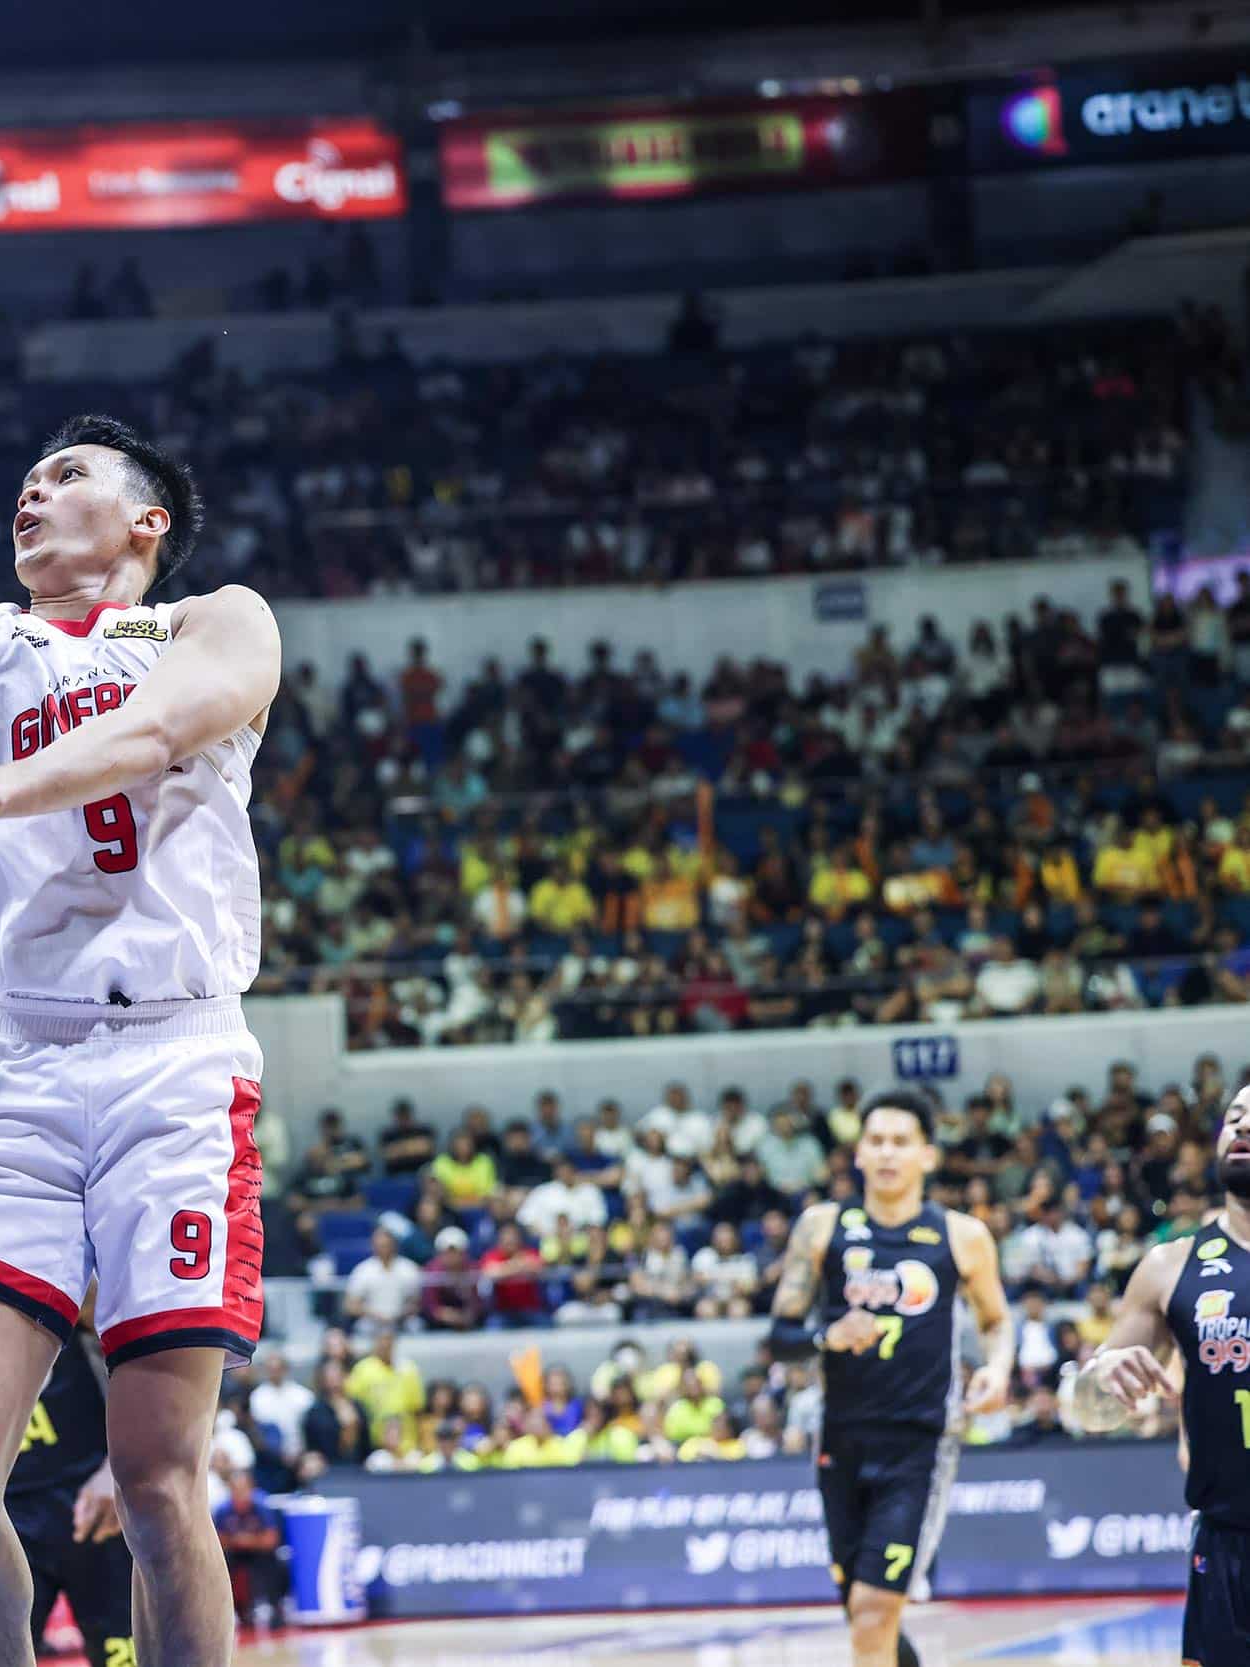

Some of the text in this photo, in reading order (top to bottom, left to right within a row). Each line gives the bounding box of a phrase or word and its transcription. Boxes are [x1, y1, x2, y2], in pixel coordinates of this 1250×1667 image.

[11, 682, 138, 761] GINEB
[83, 792, 138, 874] 9
[170, 1209, 212, 1280] 9
[875, 1315, 903, 1360] 7
[1199, 1317, 1250, 1343] TROPA
[1199, 1338, 1250, 1374] gig
[883, 1542, 914, 1582] 7
